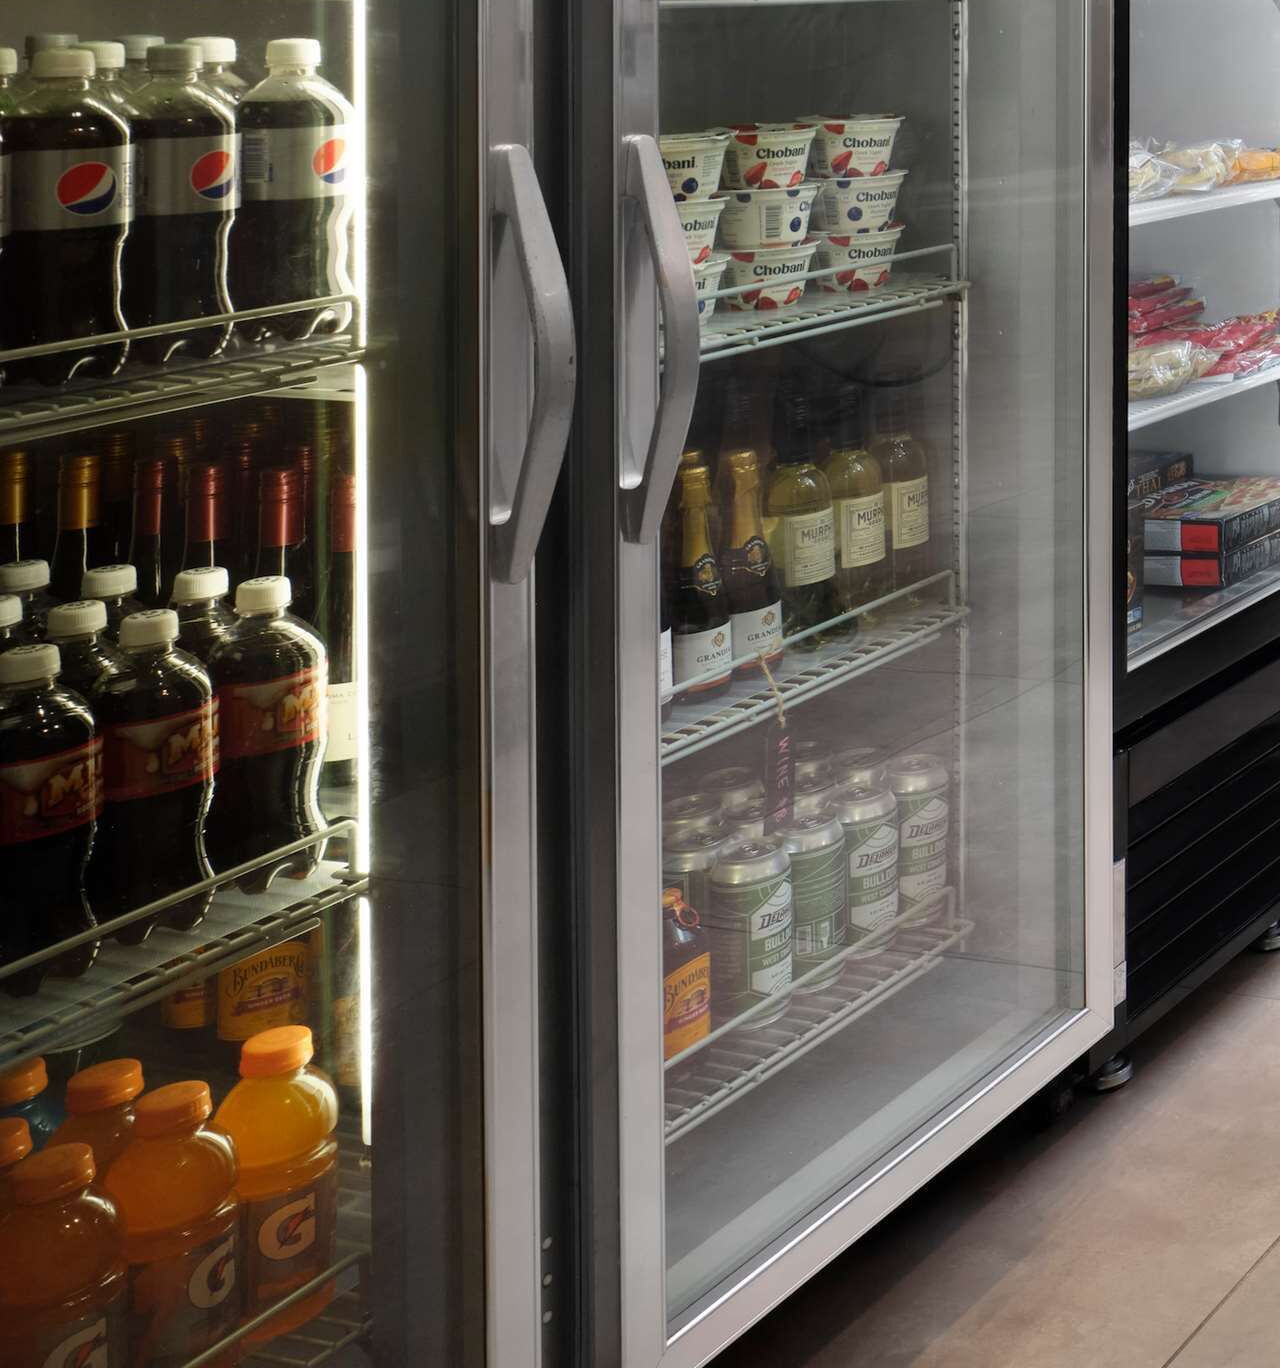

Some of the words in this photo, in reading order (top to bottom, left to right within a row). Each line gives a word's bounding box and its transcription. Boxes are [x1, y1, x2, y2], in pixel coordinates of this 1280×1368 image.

[843, 135, 890, 149] Chobani
[756, 144, 807, 160] Chobani
[753, 260, 805, 277] Chobani
